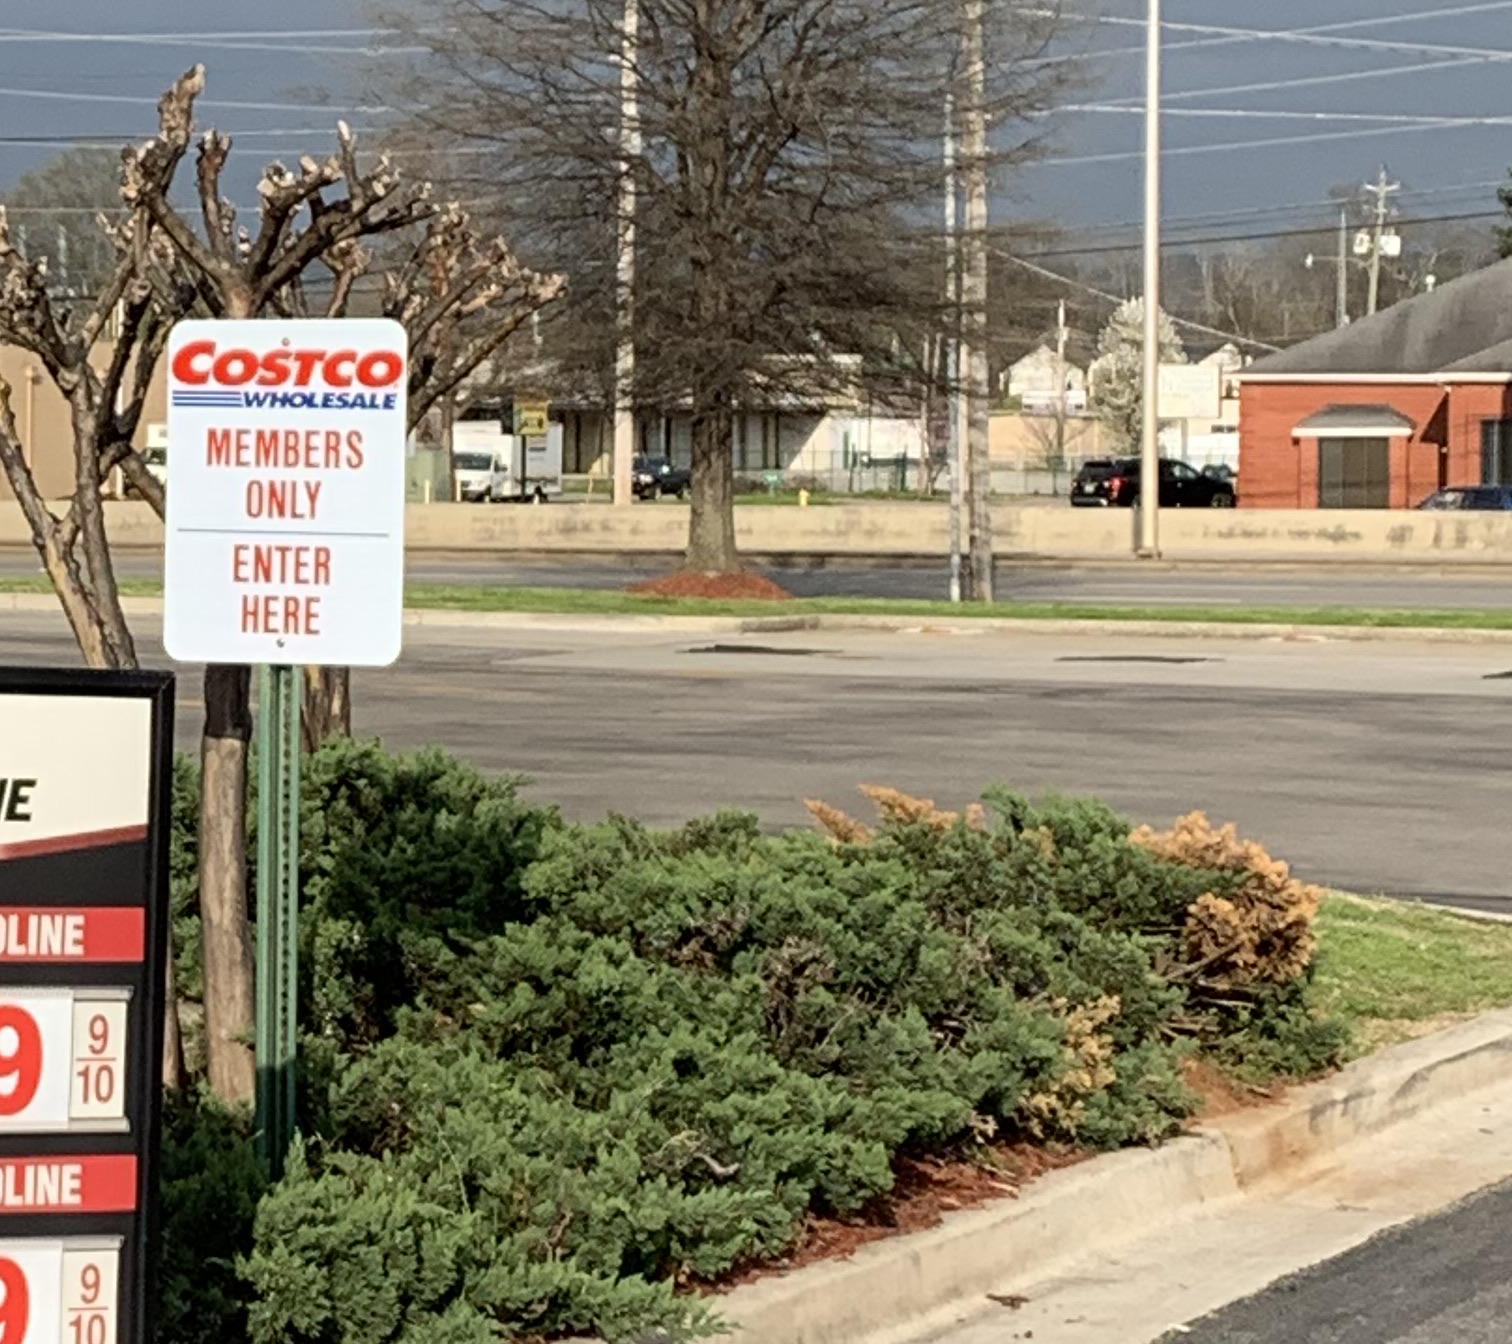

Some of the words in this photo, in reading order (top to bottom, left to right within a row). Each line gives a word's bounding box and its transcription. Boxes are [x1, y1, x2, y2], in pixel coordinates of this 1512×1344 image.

[172, 340, 403, 388] COSTCO
[241, 391, 397, 410] WHOLESALE
[205, 428, 364, 469] MEMBERS
[246, 480, 322, 519] ONLY
[233, 544, 331, 585] ENTER
[241, 595, 320, 635] HERE
